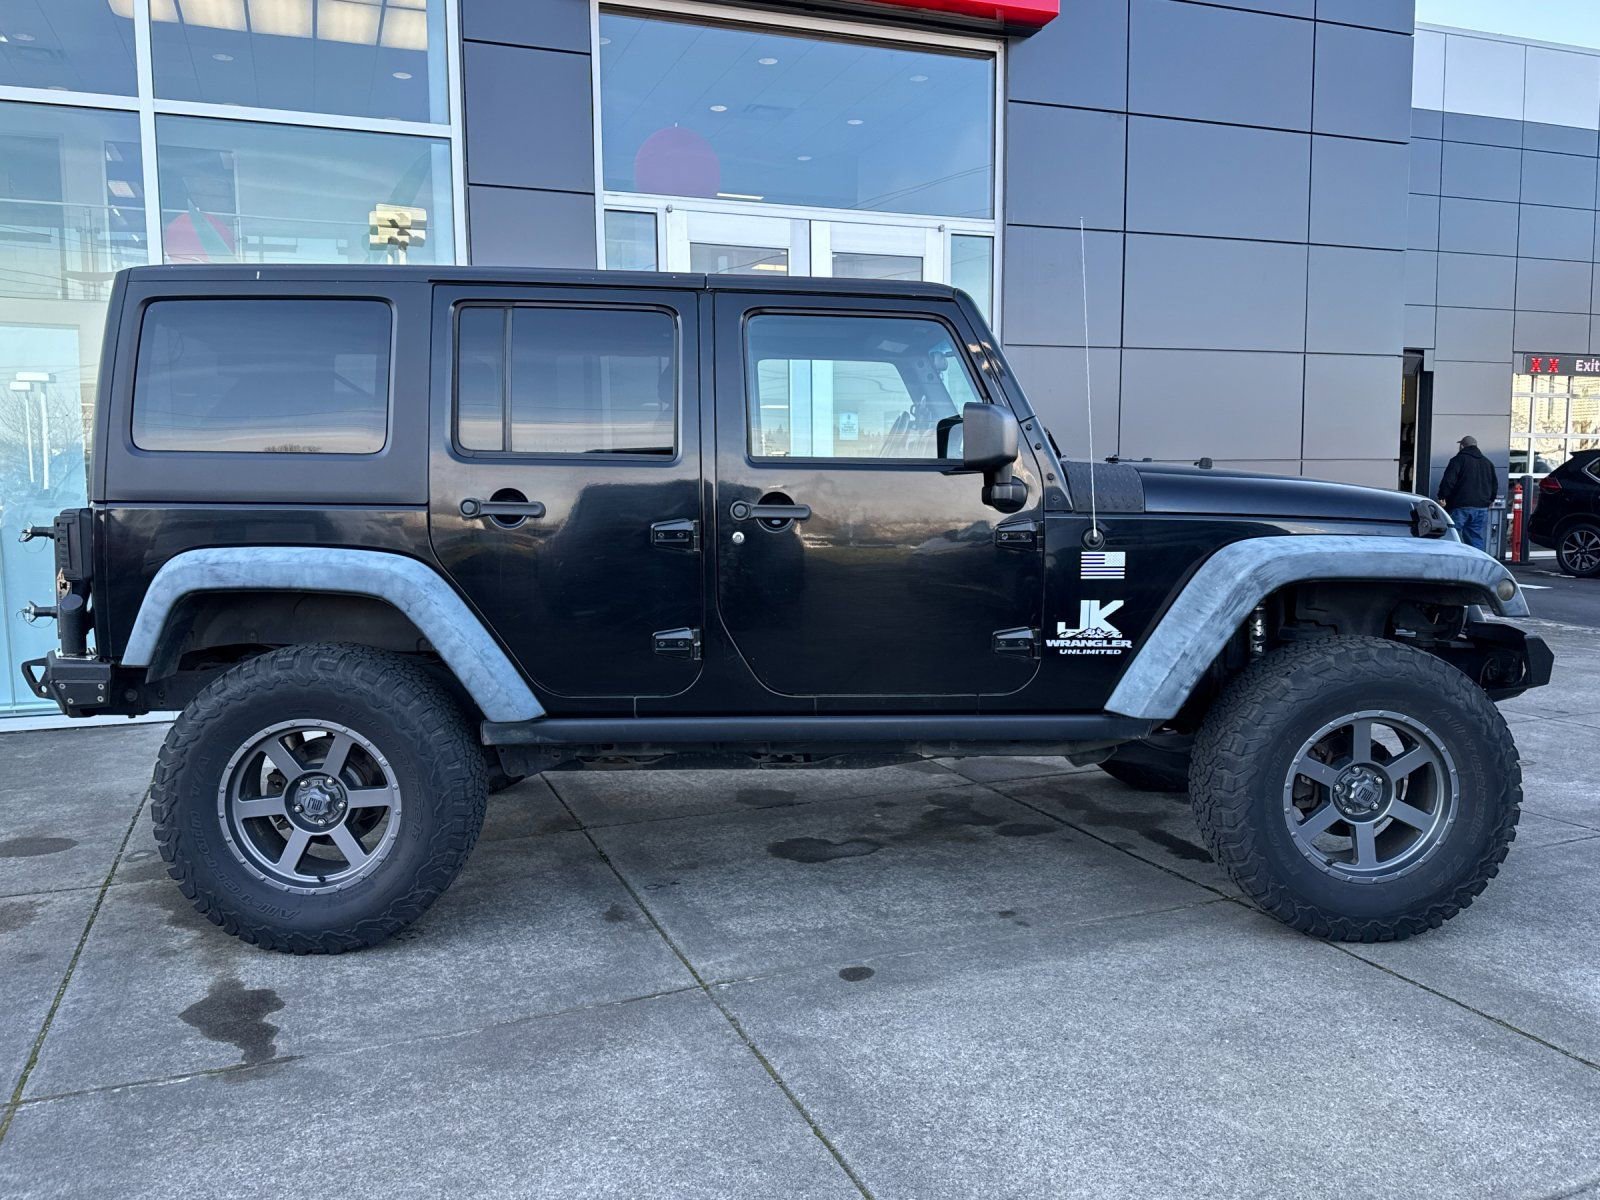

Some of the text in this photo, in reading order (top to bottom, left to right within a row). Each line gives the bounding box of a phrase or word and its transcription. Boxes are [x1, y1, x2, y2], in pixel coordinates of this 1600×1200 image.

[1575, 359, 1600, 372] Exit
[1057, 600, 1124, 638] JK
[1045, 639, 1132, 648] WRANGLER
